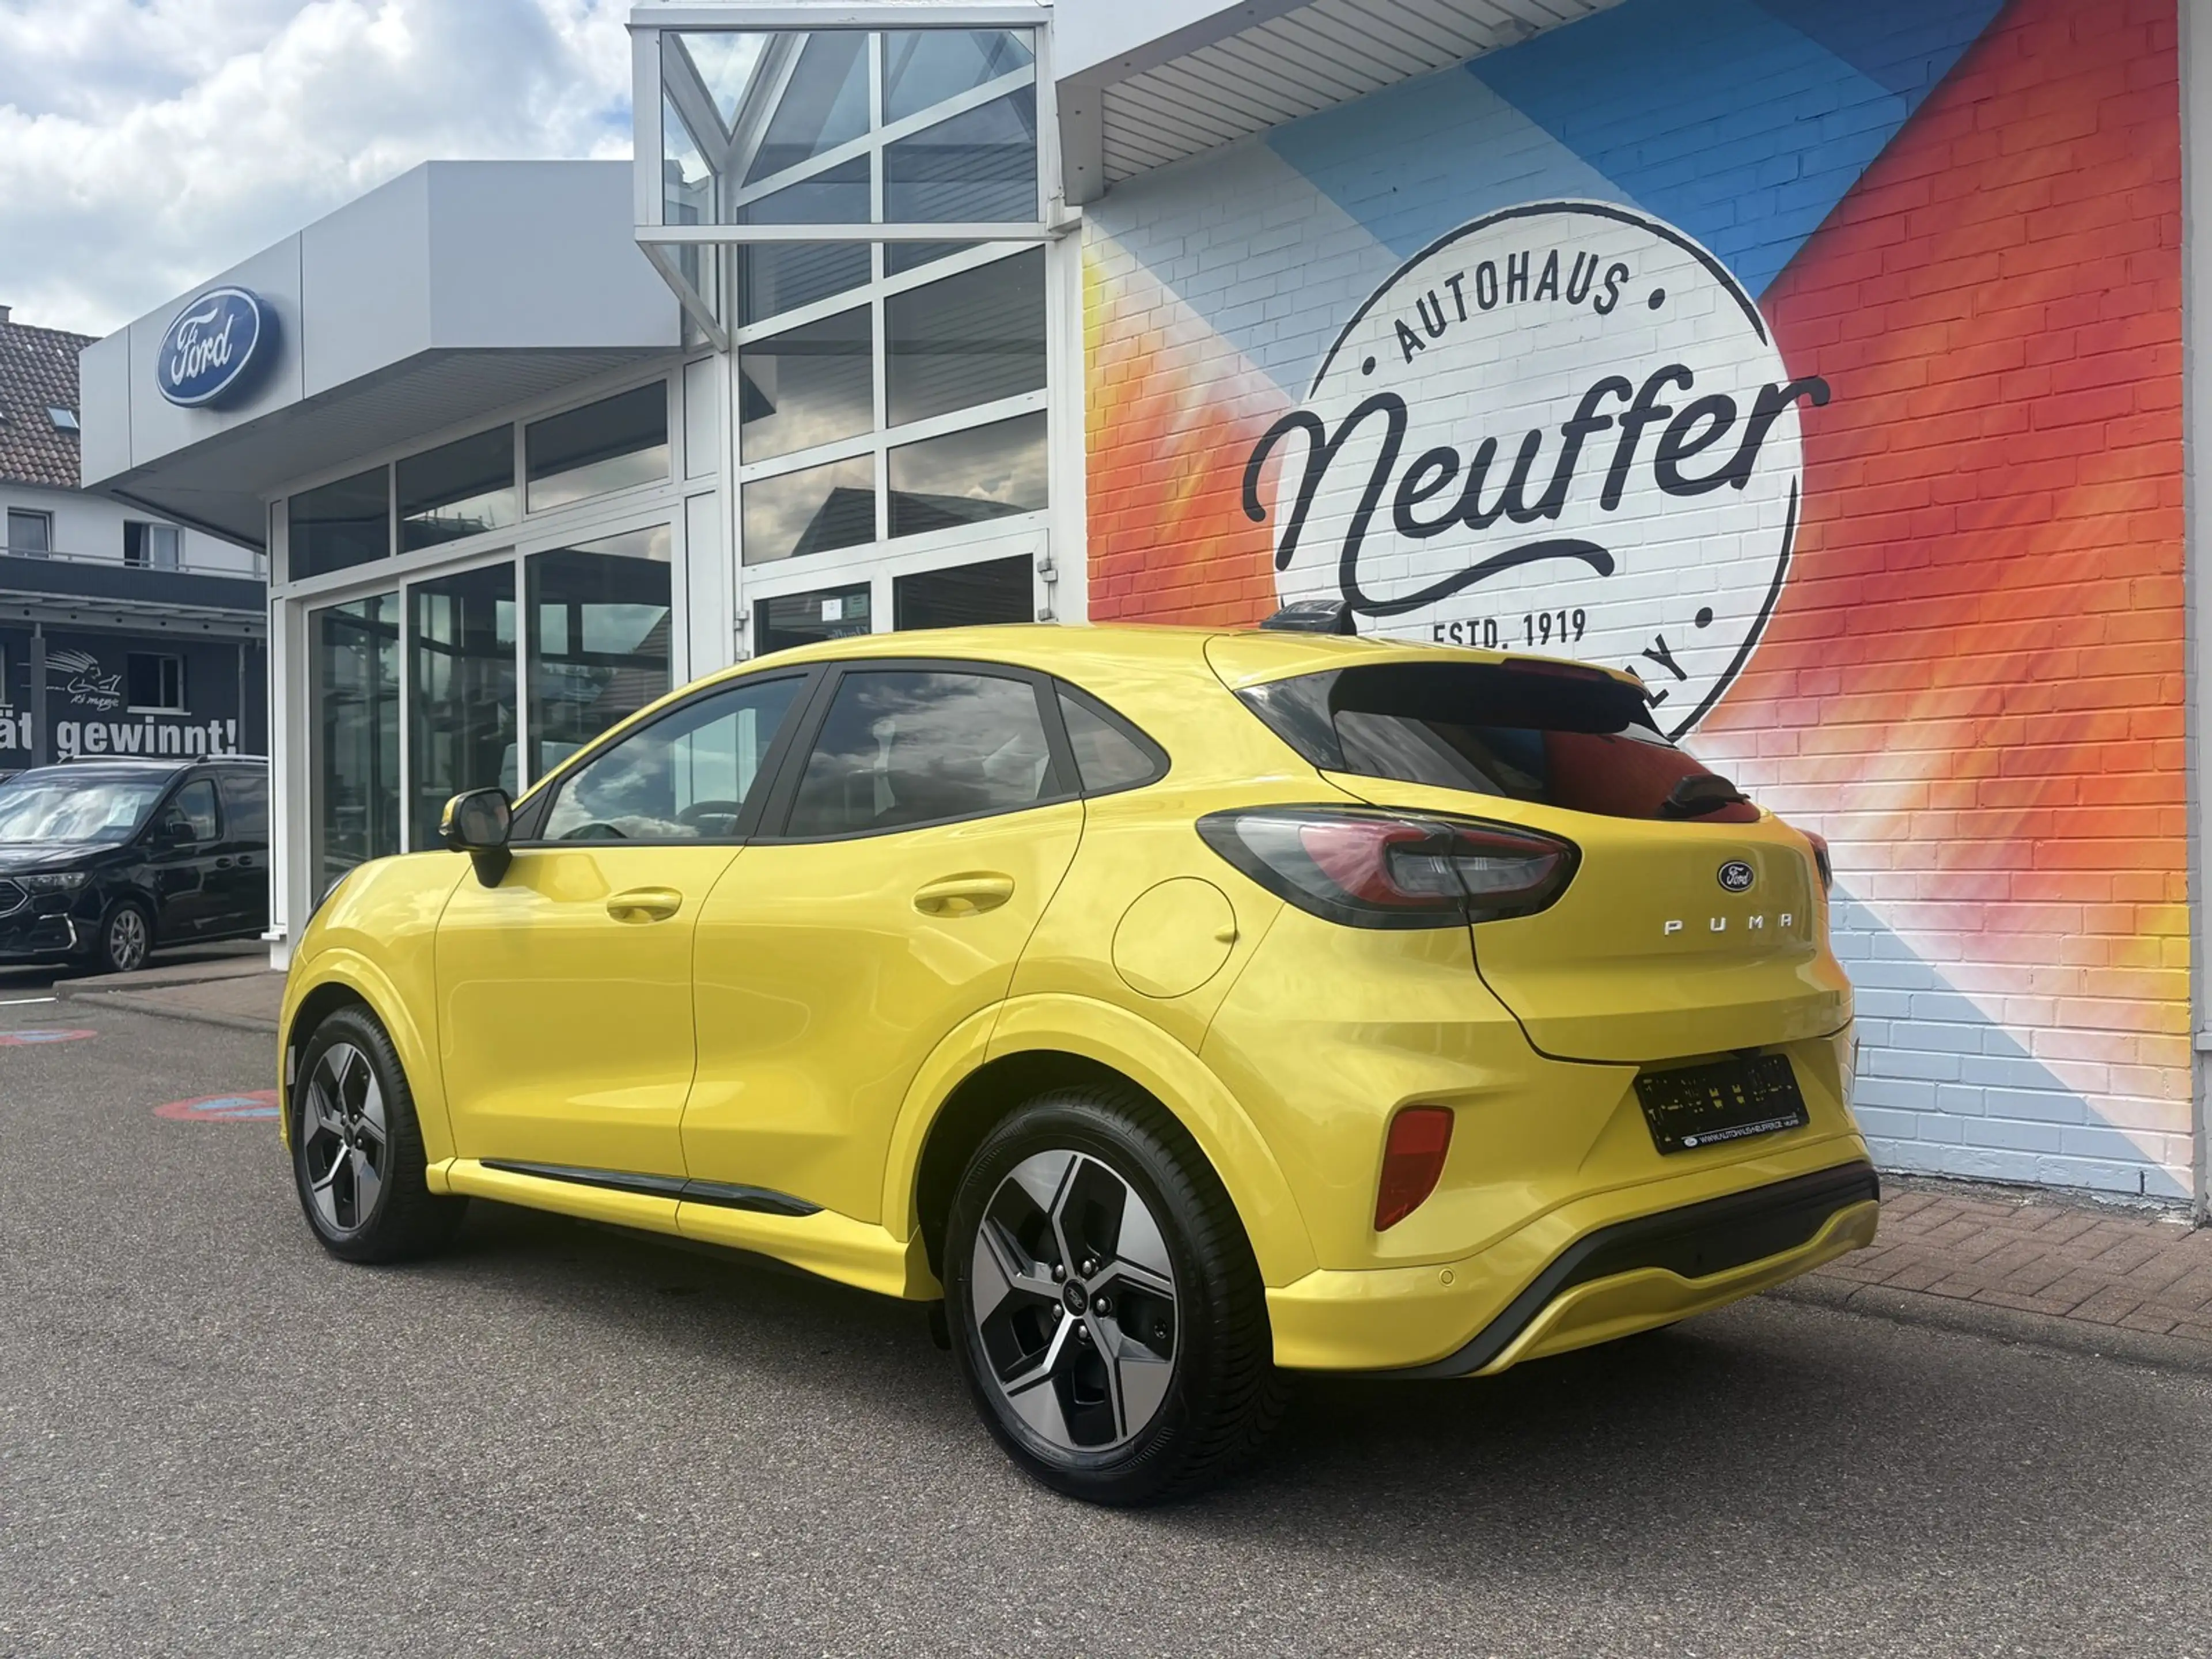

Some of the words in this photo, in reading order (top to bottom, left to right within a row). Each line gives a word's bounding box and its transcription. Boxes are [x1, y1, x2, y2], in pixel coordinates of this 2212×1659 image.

[1394, 249, 1629, 364] AUTOHAUS
[171, 308, 234, 385] Ford
[1243, 363, 1831, 616] Neuffer
[1524, 609, 1585, 646] 1919
[57, 716, 236, 763] gewinnt!
[1727, 865, 1749, 885] Ford
[1664, 913, 1792, 935] PUMA
